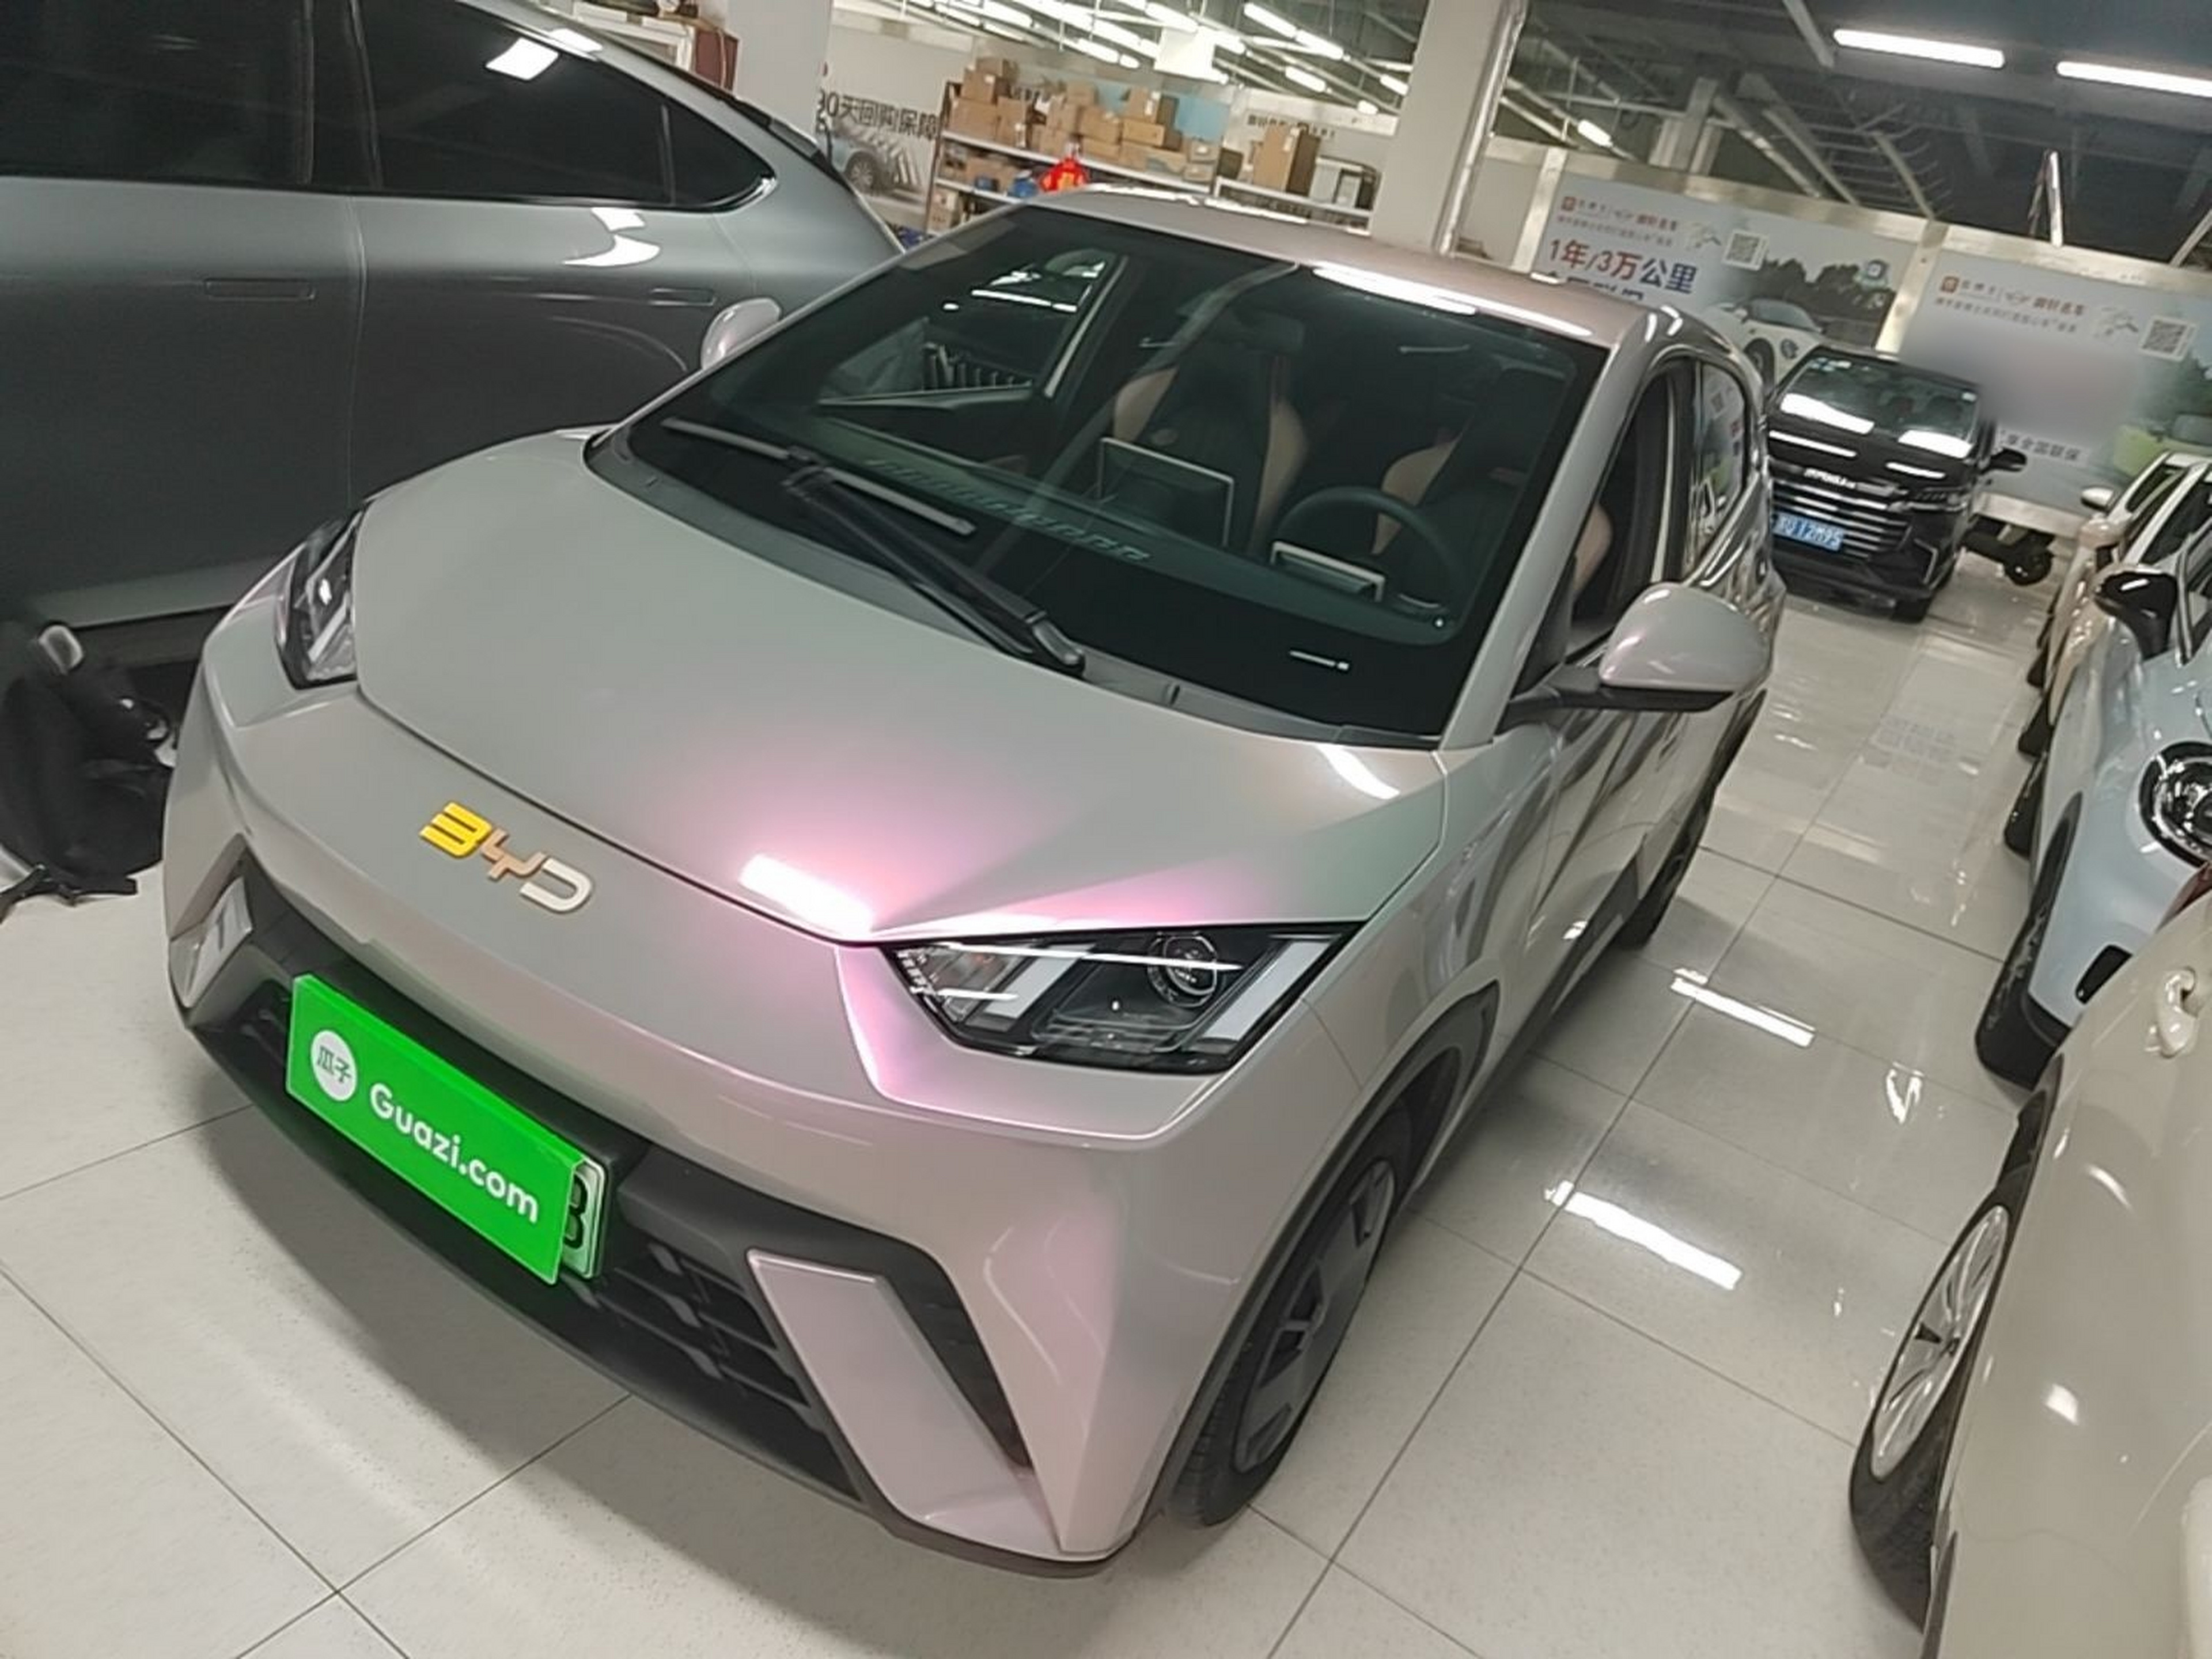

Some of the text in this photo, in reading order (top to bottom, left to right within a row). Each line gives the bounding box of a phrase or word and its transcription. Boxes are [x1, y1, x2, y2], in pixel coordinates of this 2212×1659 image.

[1548, 238, 1698, 294] 1年/3万公里
[419, 801, 593, 914] BYD
[316, 1044, 352, 1084] 瓜子
[369, 1082, 539, 1224] Guazi.com
